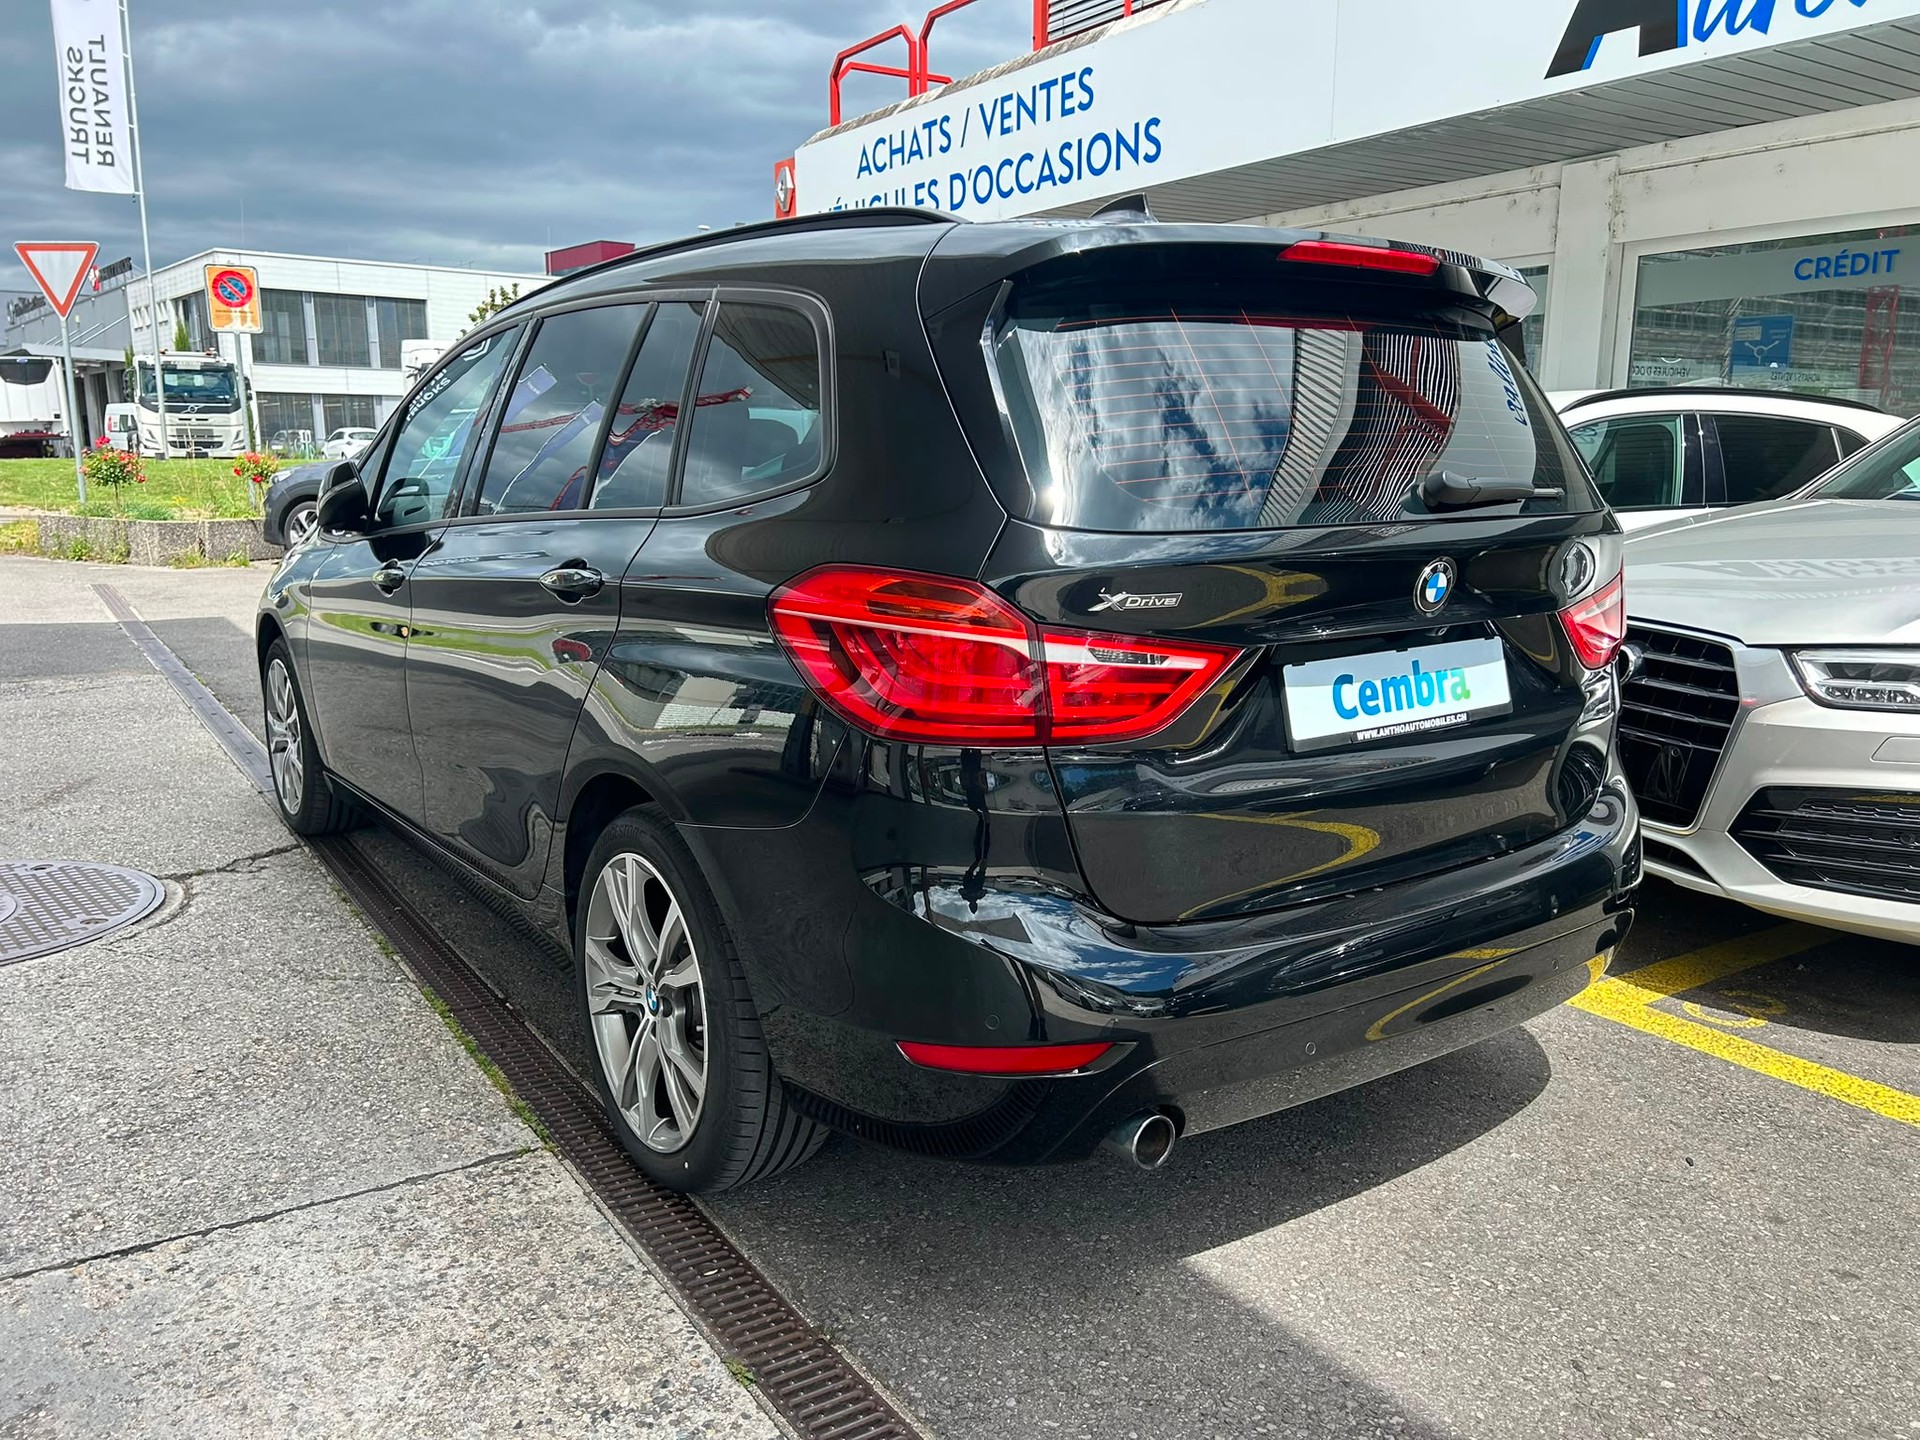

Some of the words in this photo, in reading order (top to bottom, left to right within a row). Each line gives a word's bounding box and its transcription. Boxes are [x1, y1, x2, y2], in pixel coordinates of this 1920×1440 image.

[857, 114, 952, 180] ACHATS
[978, 67, 1095, 139] VENTES
[950, 117, 1163, 211] D'OCCASIONS
[1794, 249, 1901, 281] CRÉDIT
[1332, 659, 1471, 720] Cembra
[1356, 711, 1468, 742] WWW.ANTHOAUTOMOBILES.CH
